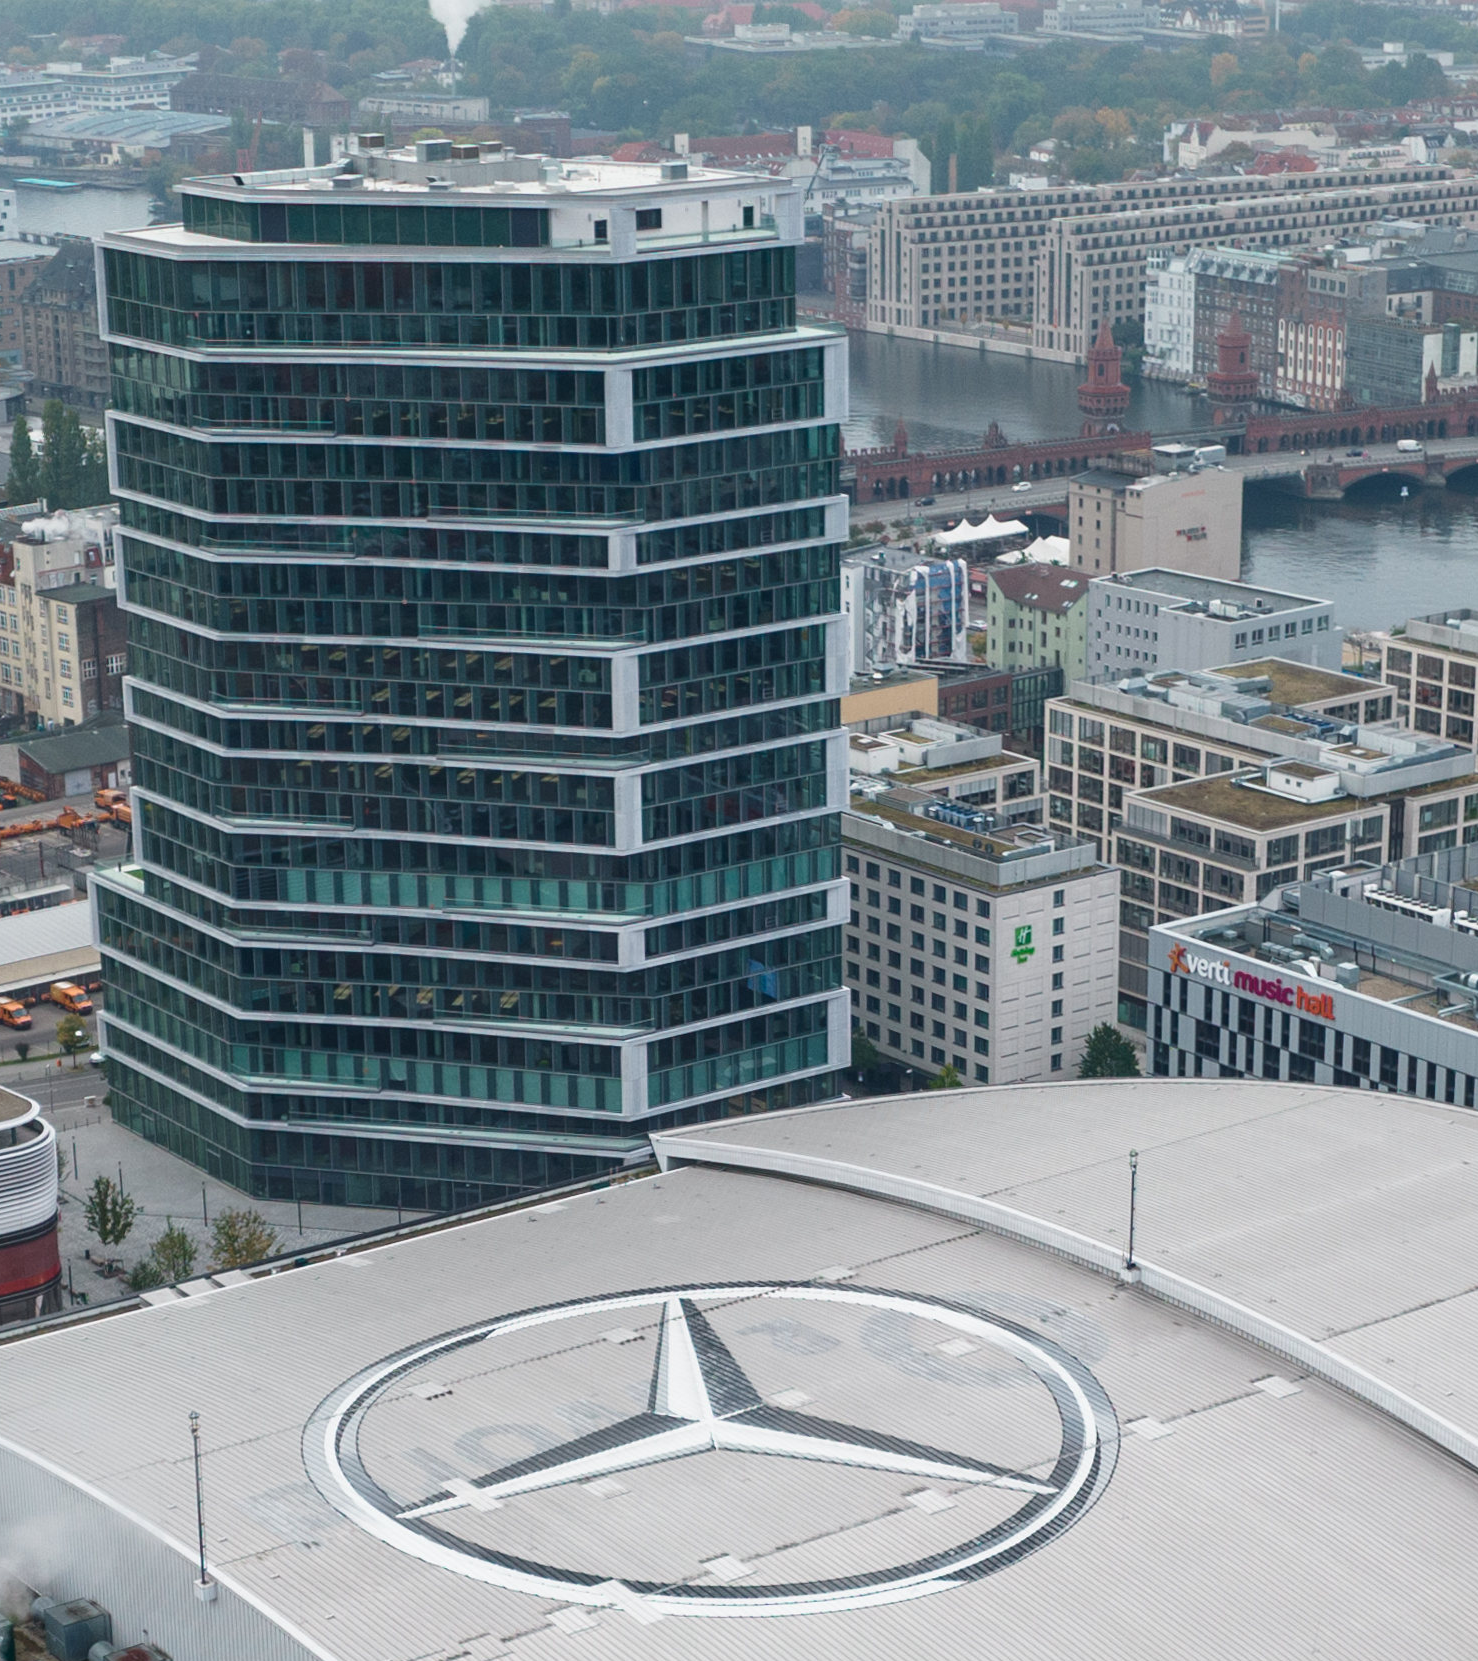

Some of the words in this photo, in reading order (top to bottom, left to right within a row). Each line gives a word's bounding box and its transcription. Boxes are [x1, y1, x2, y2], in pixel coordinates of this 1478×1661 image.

[1186, 942, 1231, 986] verti
[1234, 970, 1294, 1006] music
[1296, 985, 1335, 1020] hall
